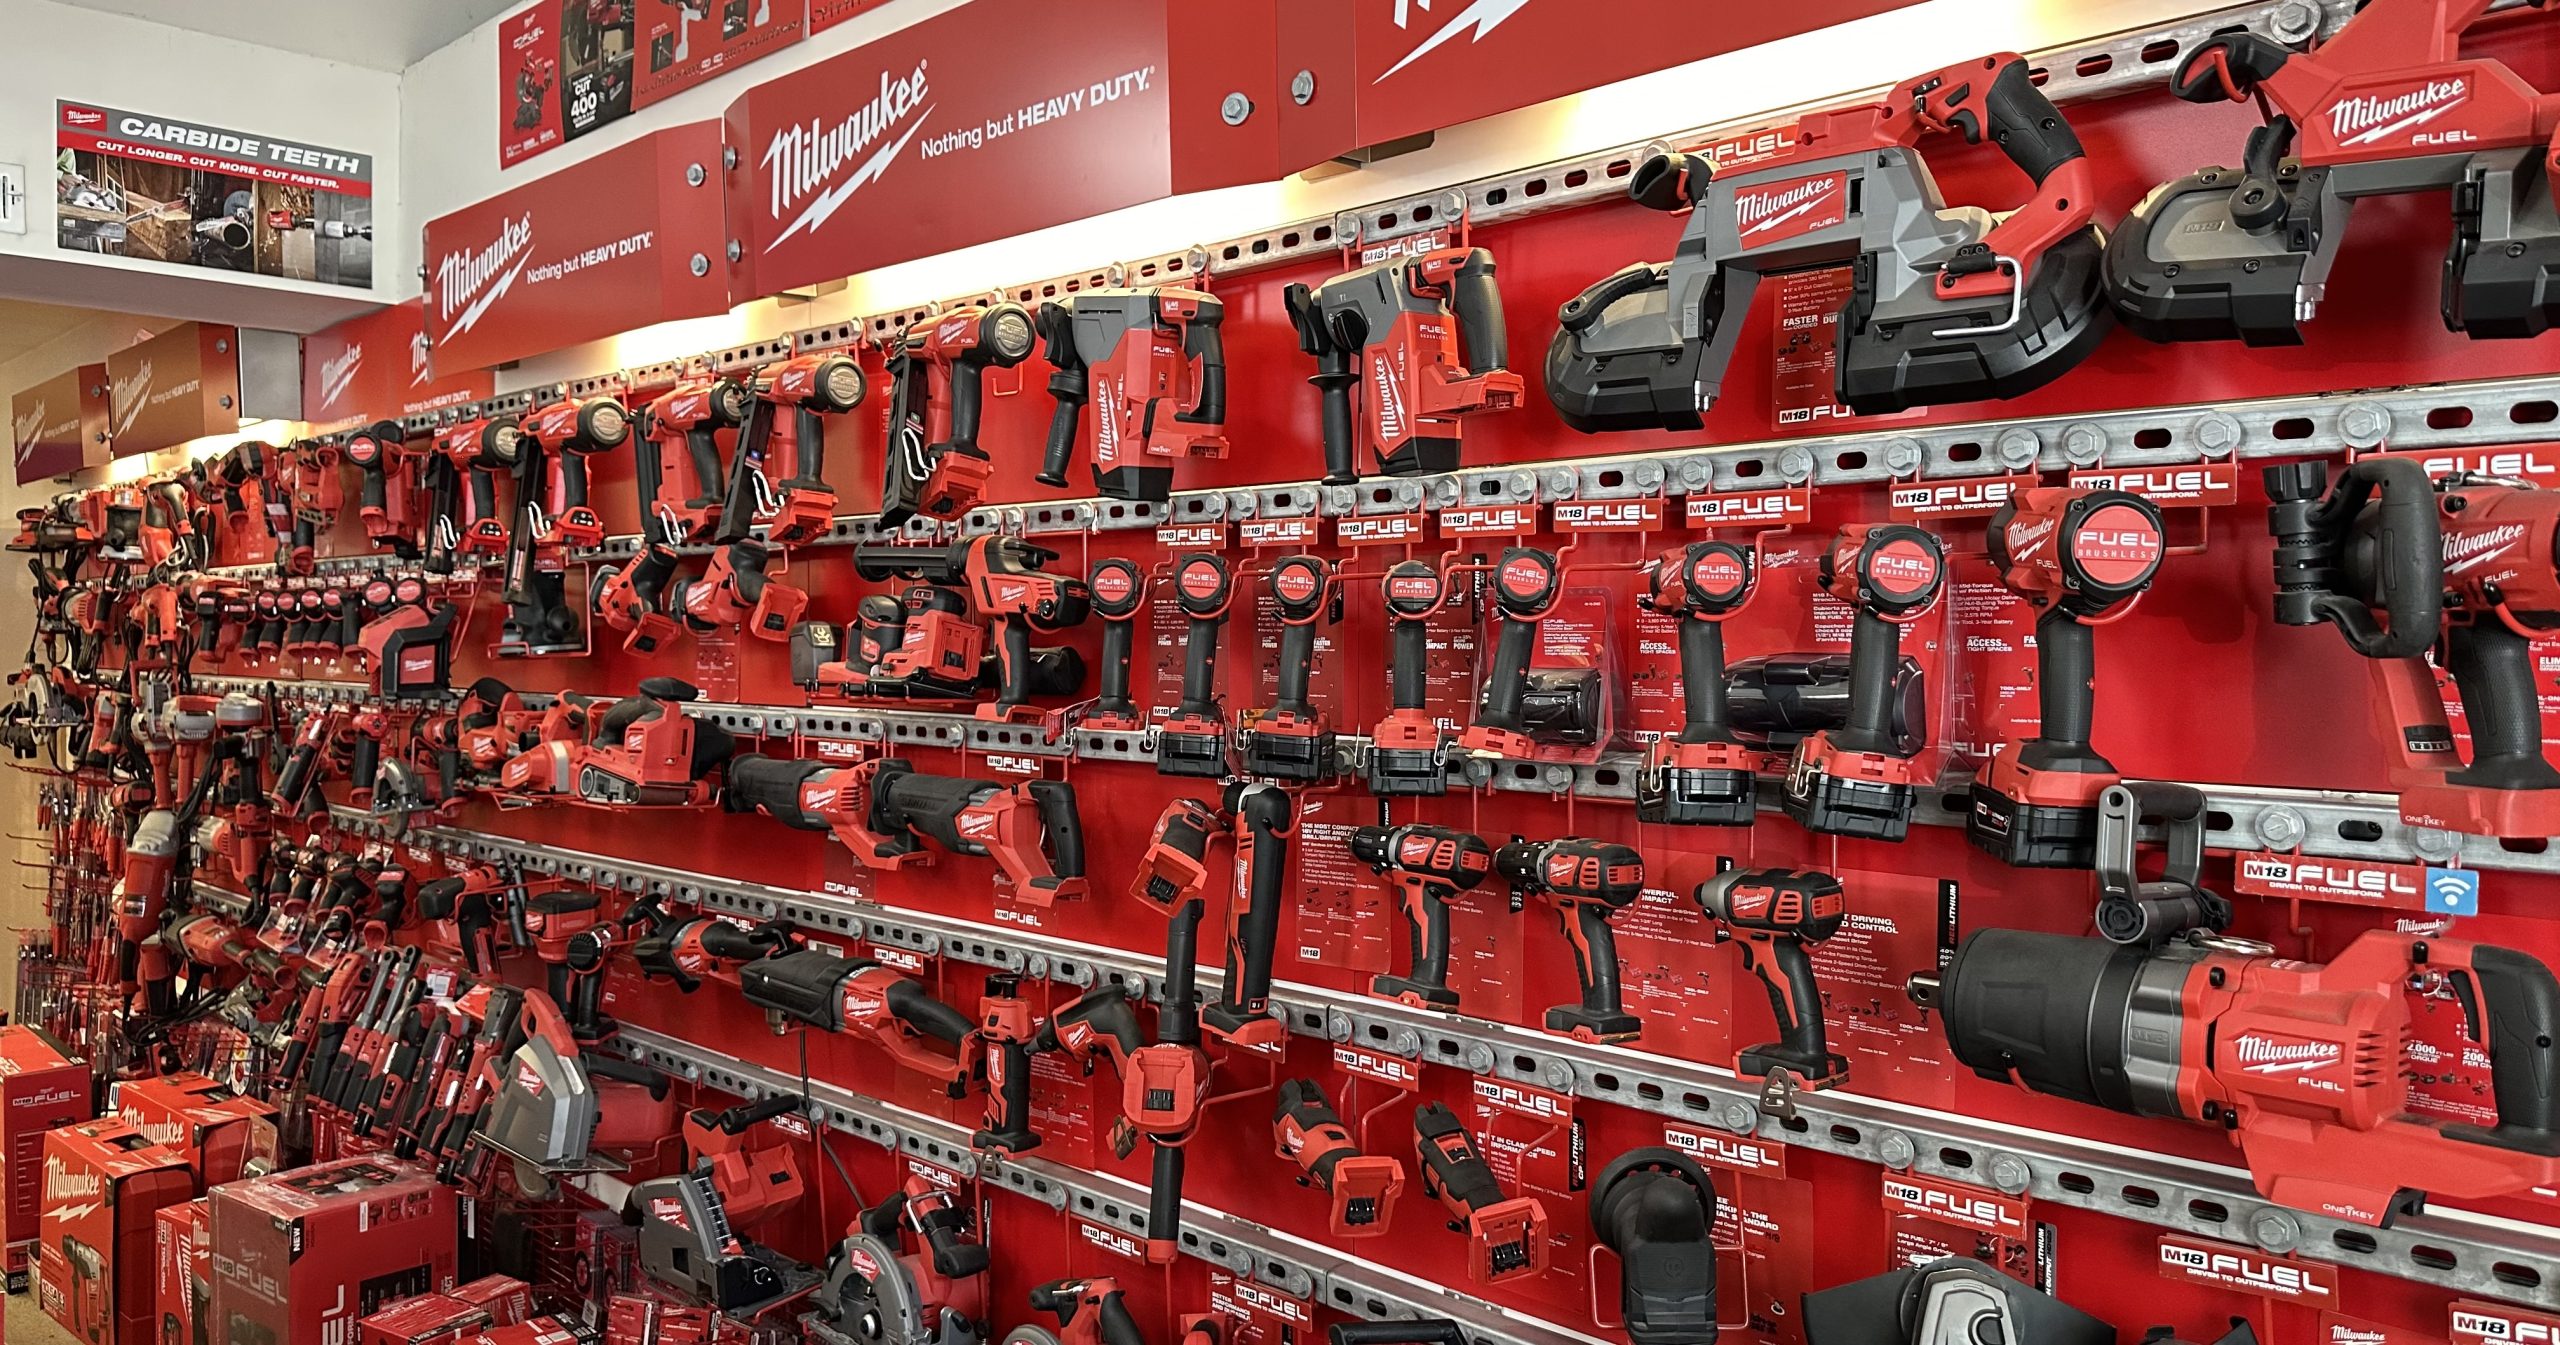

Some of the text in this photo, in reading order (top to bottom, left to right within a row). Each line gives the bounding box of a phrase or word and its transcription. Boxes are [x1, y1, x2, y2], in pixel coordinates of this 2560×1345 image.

[575, 79, 591, 96] CUT
[571, 92, 598, 117] 400
[2326, 77, 2465, 137] Milwaukee
[67, 110, 102, 121] Milwaukee
[921, 128, 982, 159] Nothing
[986, 112, 1014, 140] but
[1017, 89, 1087, 131] HEAVY
[120, 117, 360, 174] CARBIDE TEETH
[2412, 130, 2477, 145] FUEL
[1715, 133, 1796, 160] FUEL
[96, 140, 340, 189] CUT LONGER. CUT MORE. CUT FASTER.
[1735, 176, 1836, 226] Milwaukee
[1809, 217, 1840, 231] FUEL
[1387, 237, 1446, 260] FUEL
[527, 266, 562, 284] Nothing
[563, 255, 579, 271] but
[581, 242, 617, 269] HEAVY
[1783, 315, 1818, 326] FASTER
[1419, 324, 1447, 334] FUEL
[1153, 346, 1175, 354] FUEL
[113, 357, 152, 423] Milwaukee
[172, 383, 185, 399] HEAVY
[433, 394, 451, 406] HEAVY
[1375, 356, 1400, 442] Milwaukee
[1098, 380, 1114, 463] Milwaukee
[1780, 409, 1809, 423] M18
[2423, 452, 2555, 477] FUEL
[2073, 471, 2229, 492] M18 FUEL
[1688, 497, 1804, 515] M18 FUEL
[1894, 491, 1929, 505] M18
[1557, 505, 1658, 520] M18 FUEL
[1914, 505, 1941, 513] DRIVEN
[1442, 509, 1531, 526] M18 FUEL
[1158, 528, 1222, 541] M18 FUEL
[1242, 523, 1314, 536] M18 FUEL
[1339, 519, 1420, 536] M18 FUEL
[2008, 518, 2054, 549] Milwaukee
[2079, 531, 2158, 547] FUEL
[2077, 549, 2157, 560] BRUSHLESS
[1505, 565, 1545, 579] FUEL
[1698, 565, 1737, 575] FUEL
[1877, 557, 1931, 571] FUEL
[2036, 559, 2058, 569] FUEL
[1097, 578, 1128, 586] FUEL
[1183, 572, 1217, 582] FUEL
[1278, 575, 1314, 585] FUEL
[2484, 569, 2518, 582] FUEL
[1395, 581, 1432, 589] FUEL
[1453, 642, 1474, 650] POWER
[1640, 642, 1667, 650] ACCESS
[1967, 639, 2002, 647] ACCESS
[1635, 732, 1660, 742] M18
[831, 742, 862, 756] FUEL
[1002, 756, 1040, 771] FUEL
[960, 813, 994, 830] Milwaukee
[2244, 863, 2417, 894] M18 FUEL
[837, 885, 862, 898] FUEL
[2269, 882, 2302, 891] DRIVEN
[2318, 886, 2385, 899] OUTPERFORM.
[1734, 893, 1767, 907] Milwaukee
[1009, 912, 1042, 927] FUEL
[1851, 914, 1895, 926] DRIVING,
[1851, 922, 1899, 934] CONTROL
[888, 950, 922, 968] FUEL
[1302, 948, 1320, 959] M18
[846, 995, 881, 1011] Milwaukee
[2234, 1035, 2340, 1062] Milwaukee
[2463, 1052, 2485, 1062] 200
[1335, 1051, 1414, 1080] M18 FUEL
[2298, 1077, 2345, 1092] FUEL
[34, 1088, 82, 1104] FUEL
[1475, 1081, 1568, 1116] M18 FUEL
[780, 1117, 809, 1134] FUEL
[1667, 1132, 1779, 1166] M18 FUEL
[44, 1152, 100, 1202] Milwaukee
[924, 1166, 957, 1186] FUEL
[1885, 1184, 2020, 1226] M18 FUEL
[1904, 1202, 1931, 1213] DRIVEN
[1932, 1207, 1942, 1215] TO
[1751, 1212, 1768, 1221] THE
[293, 1227, 301, 1252] NEW
[1083, 1226, 1141, 1256] M18 FUEL
[2163, 1247, 2330, 1295] M18 FUEL
[2186, 1267, 2233, 1282] DRIVEN TO
[236, 1264, 287, 1304] FUEL
[1237, 1286, 1308, 1321] M18 FUEL
[2330, 1325, 2386, 1341] Milwaukee
[2455, 1315, 2507, 1335] M18
